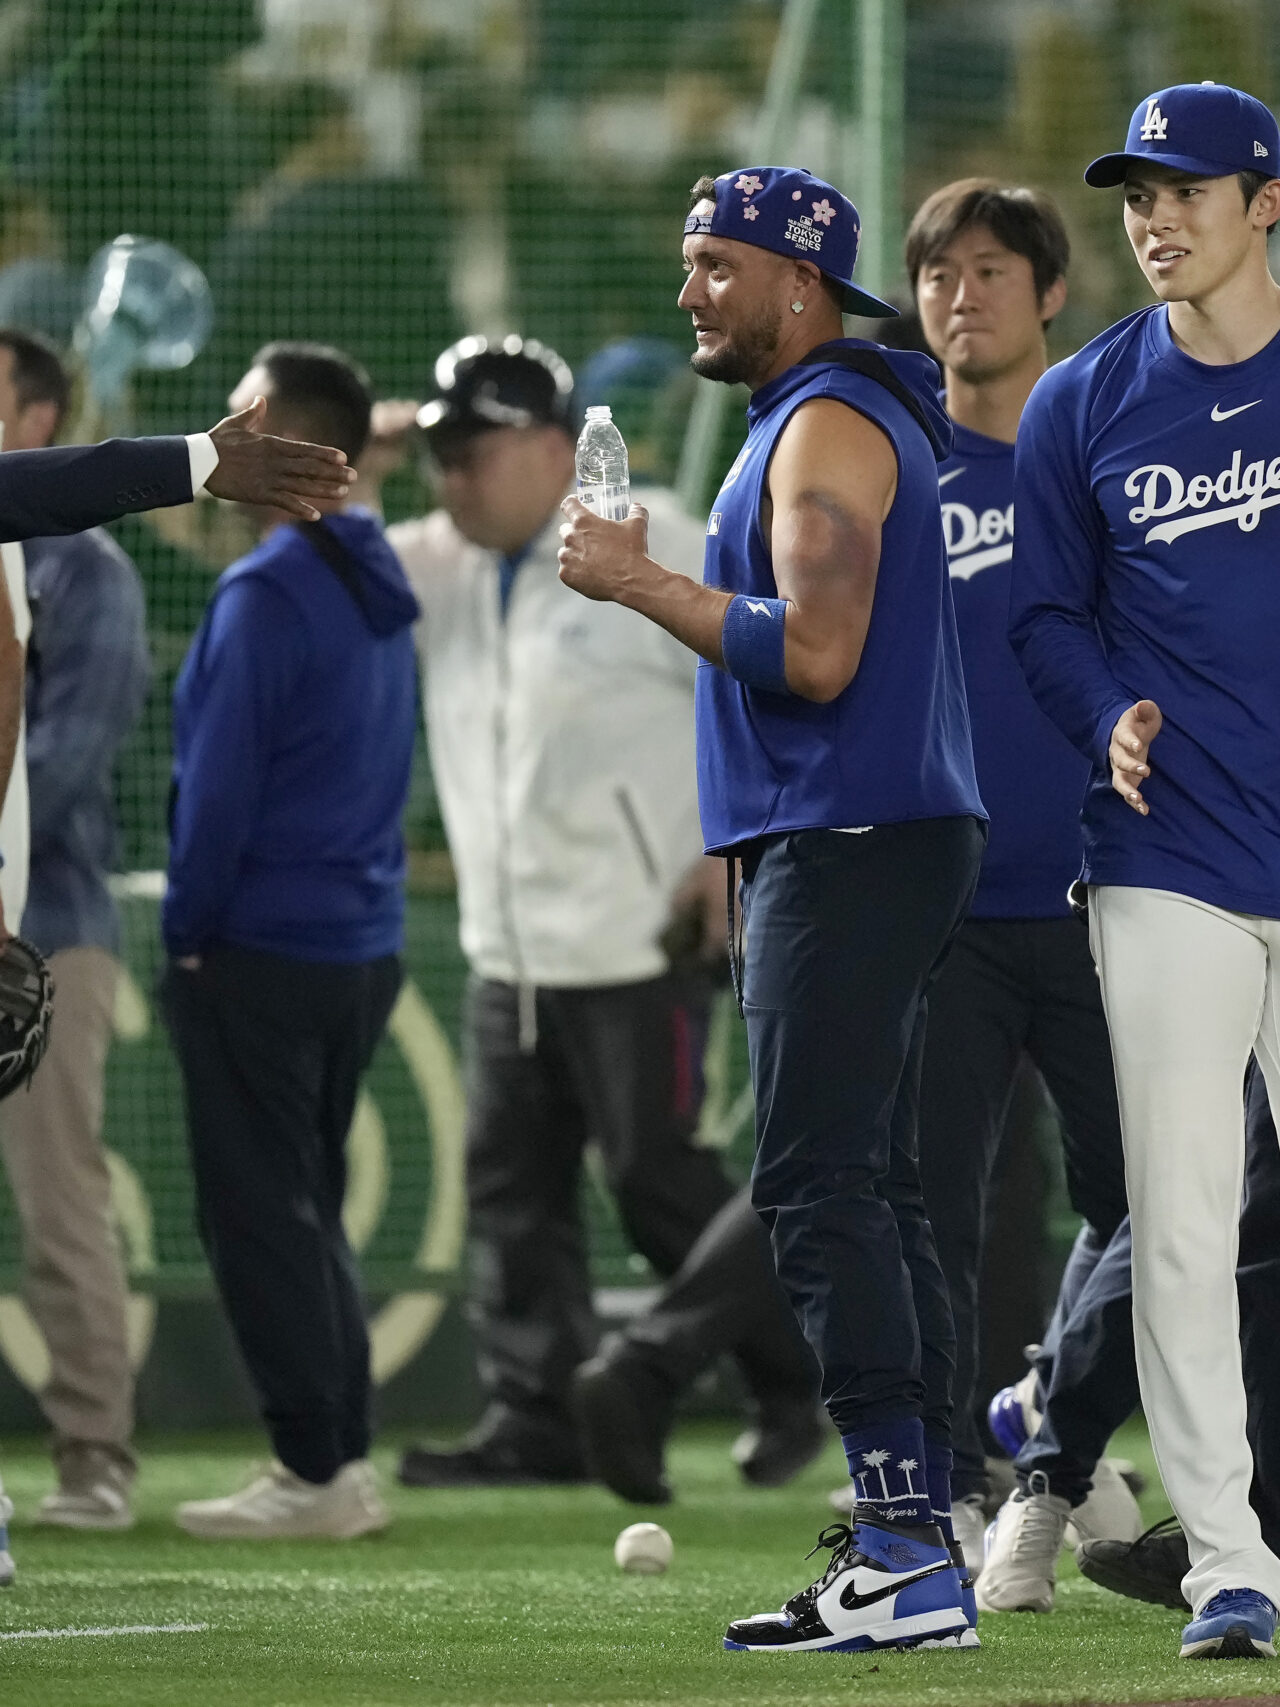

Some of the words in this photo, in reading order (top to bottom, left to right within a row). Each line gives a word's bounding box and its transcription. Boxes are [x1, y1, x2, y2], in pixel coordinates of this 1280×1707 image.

[1140, 98, 1168, 141] LA
[784, 231, 821, 251] SERIES
[788, 223, 821, 243] TOKYO
